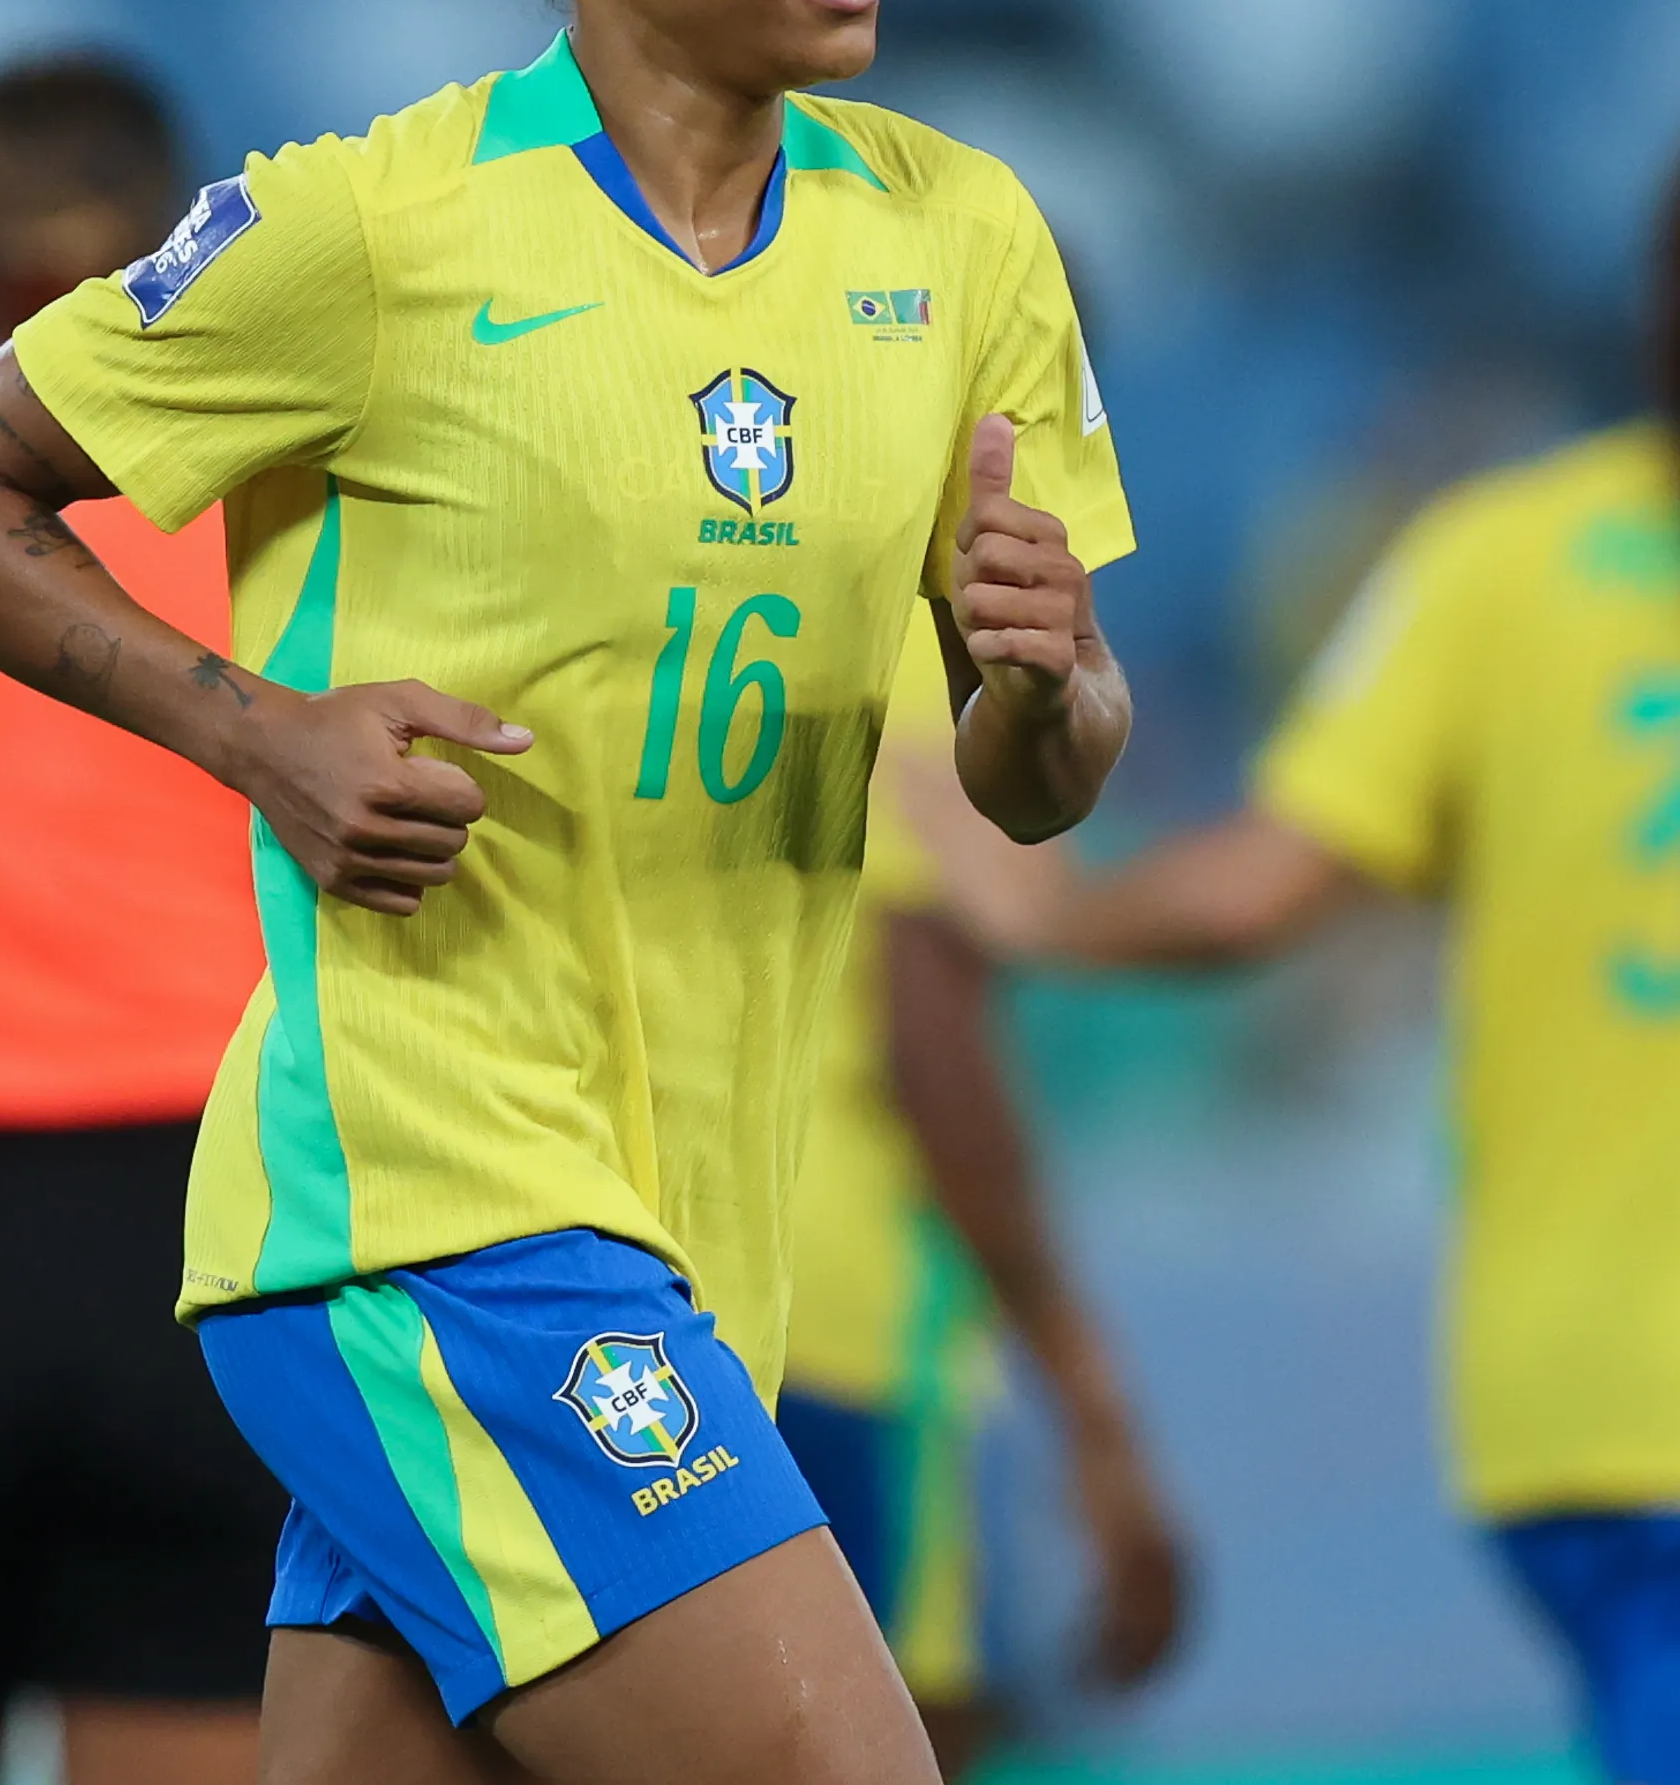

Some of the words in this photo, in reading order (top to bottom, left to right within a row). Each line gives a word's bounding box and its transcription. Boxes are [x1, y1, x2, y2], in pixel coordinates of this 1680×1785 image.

[727, 427, 763, 444] CBF
[698, 519, 800, 546] BRASIL
[633, 586, 801, 805] 16
[611, 1382, 650, 1413] CBF
[631, 1445, 739, 1517] BRASIL
